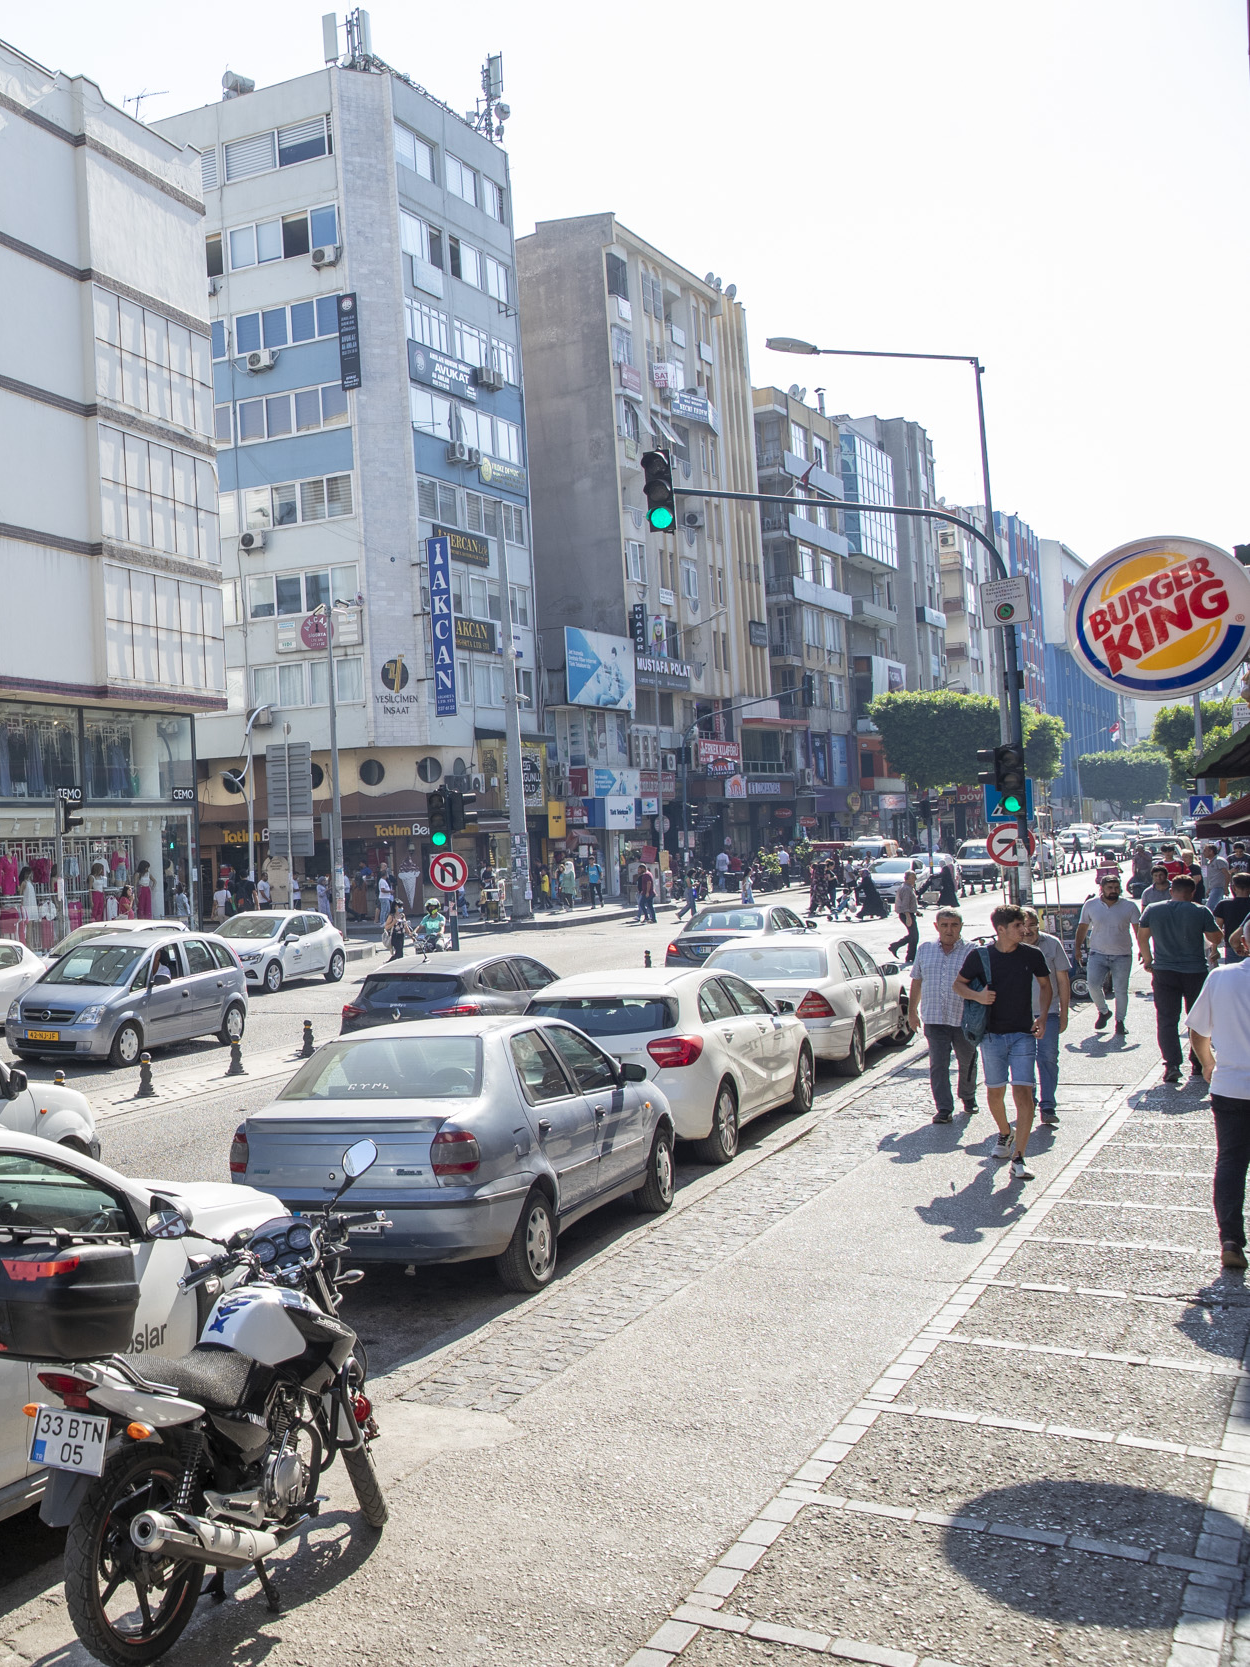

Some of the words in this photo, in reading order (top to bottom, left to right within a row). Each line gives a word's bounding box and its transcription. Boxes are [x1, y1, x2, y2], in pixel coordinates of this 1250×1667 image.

[435, 362, 470, 384] AVUKAT
[1089, 558, 1215, 641] BURGER
[432, 570, 453, 690] AKCAN
[456, 620, 487, 639] AKCAN
[1102, 579, 1229, 675] KING
[637, 657, 669, 674] MUSTAFA
[670, 662, 690, 678] POLAT
[375, 694, 418, 703] YEŞİLÇİMEN
[708, 762, 735, 772] SABAH
[173, 790, 193, 799] CEMO
[375, 824, 411, 836] Tatlım
[126, 1321, 167, 1356] oslar
[41, 1414, 63, 1436] 33
[68, 1419, 104, 1444] BTN
[60, 1442, 83, 1465] 05
